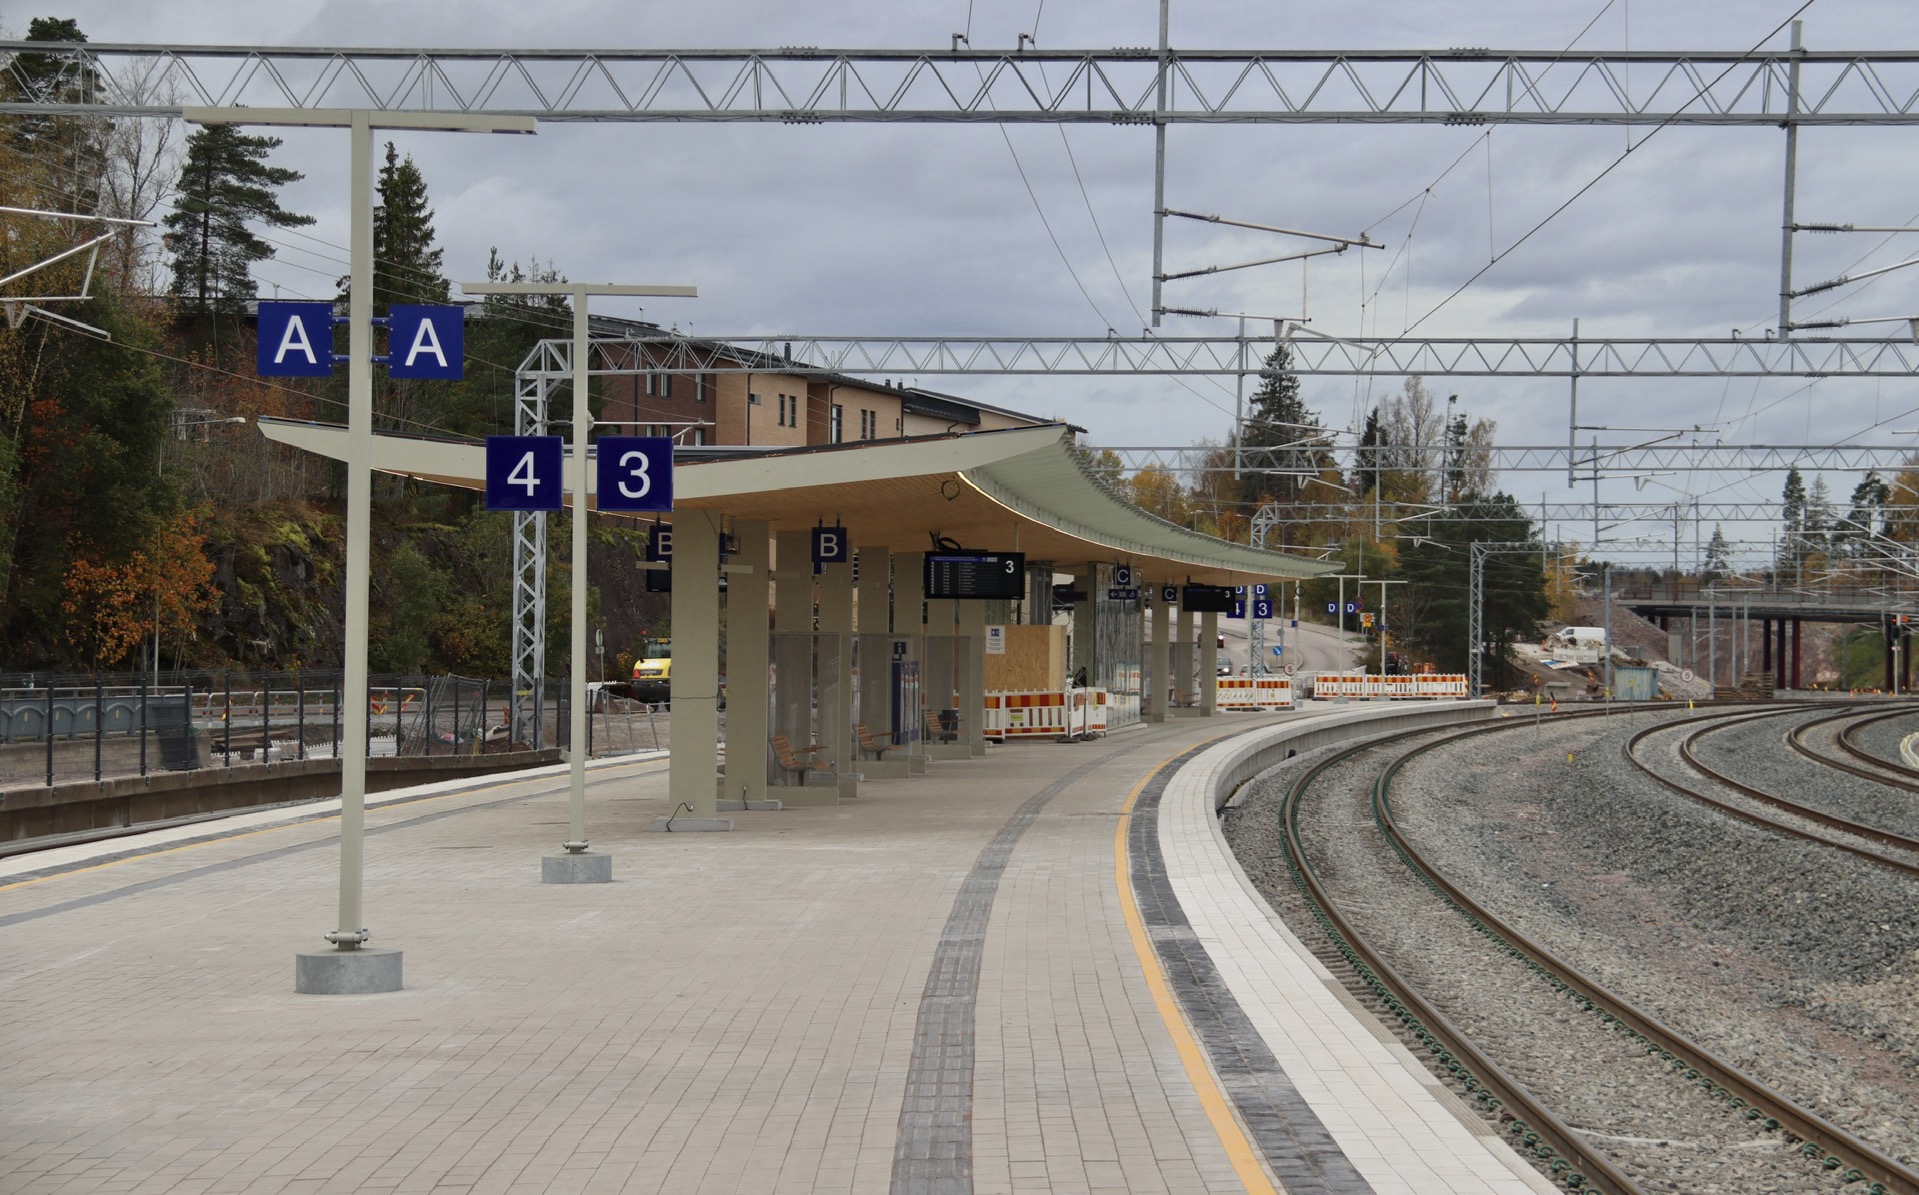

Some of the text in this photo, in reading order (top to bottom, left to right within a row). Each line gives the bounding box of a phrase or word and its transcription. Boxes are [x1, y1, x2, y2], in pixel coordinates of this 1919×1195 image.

[274, 315, 317, 364] A
[405, 318, 448, 367] A
[507, 451, 541, 497] 4
[618, 451, 651, 498] 3
[820, 534, 838, 557] B
[1005, 560, 1014, 574] 3
[1117, 569, 1129, 583] C
[1164, 588, 1174, 600] C
[1256, 585, 1265, 594] D
[1258, 603, 1267, 616] 3
[1328, 604, 1336, 612] D
[1347, 604, 1355, 612] D
